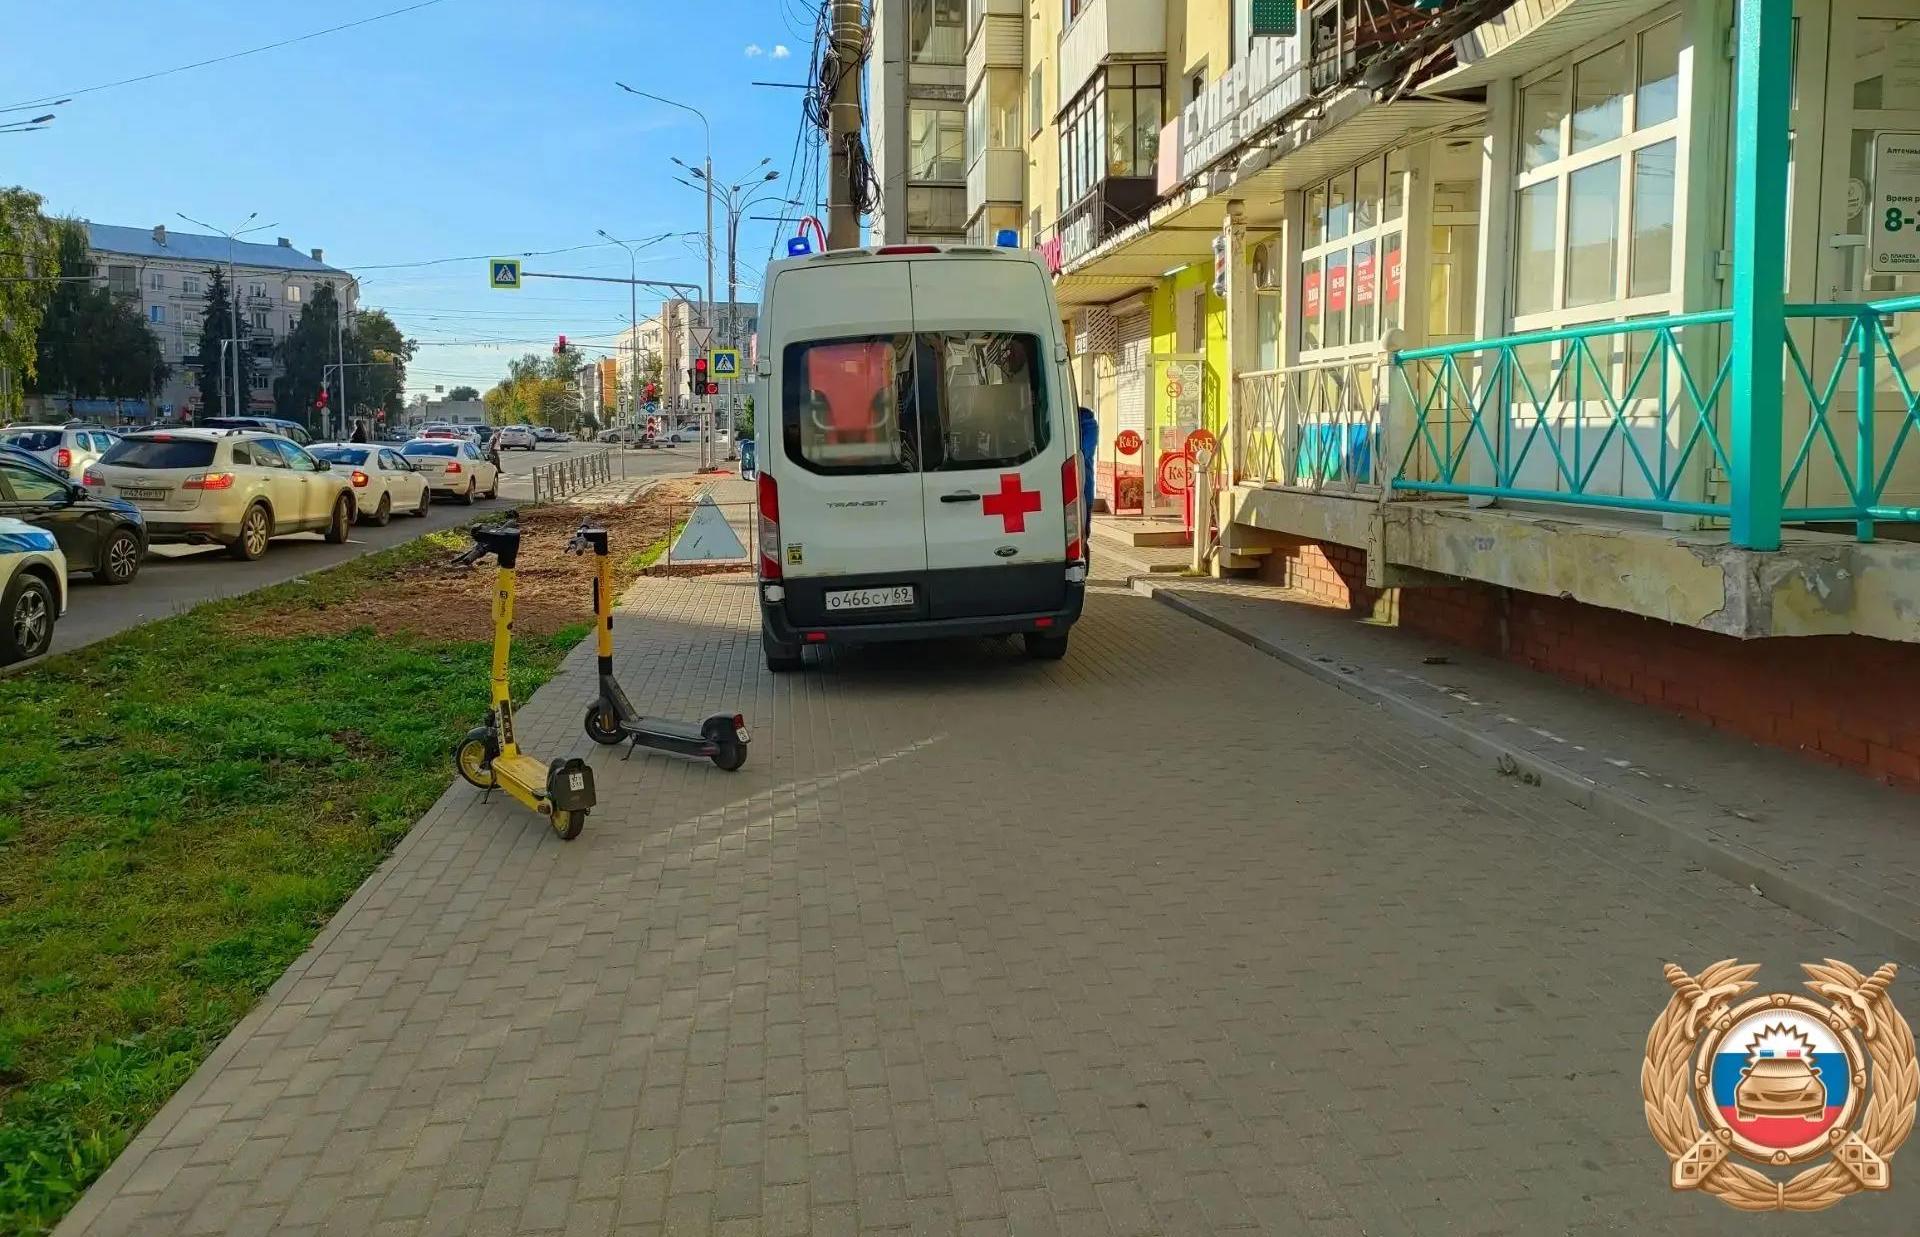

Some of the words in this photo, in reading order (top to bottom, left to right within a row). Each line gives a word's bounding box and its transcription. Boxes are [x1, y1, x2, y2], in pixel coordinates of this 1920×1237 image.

[1886, 194, 1913, 203] Время
[1885, 207, 1920, 232] 8-
[618, 396, 626, 427] СТОП
[1119, 435, 1139, 449] К&Б
[1188, 437, 1213, 452] К&Б
[826, 500, 888, 508] TRANSIT
[894, 588, 908, 599] 69
